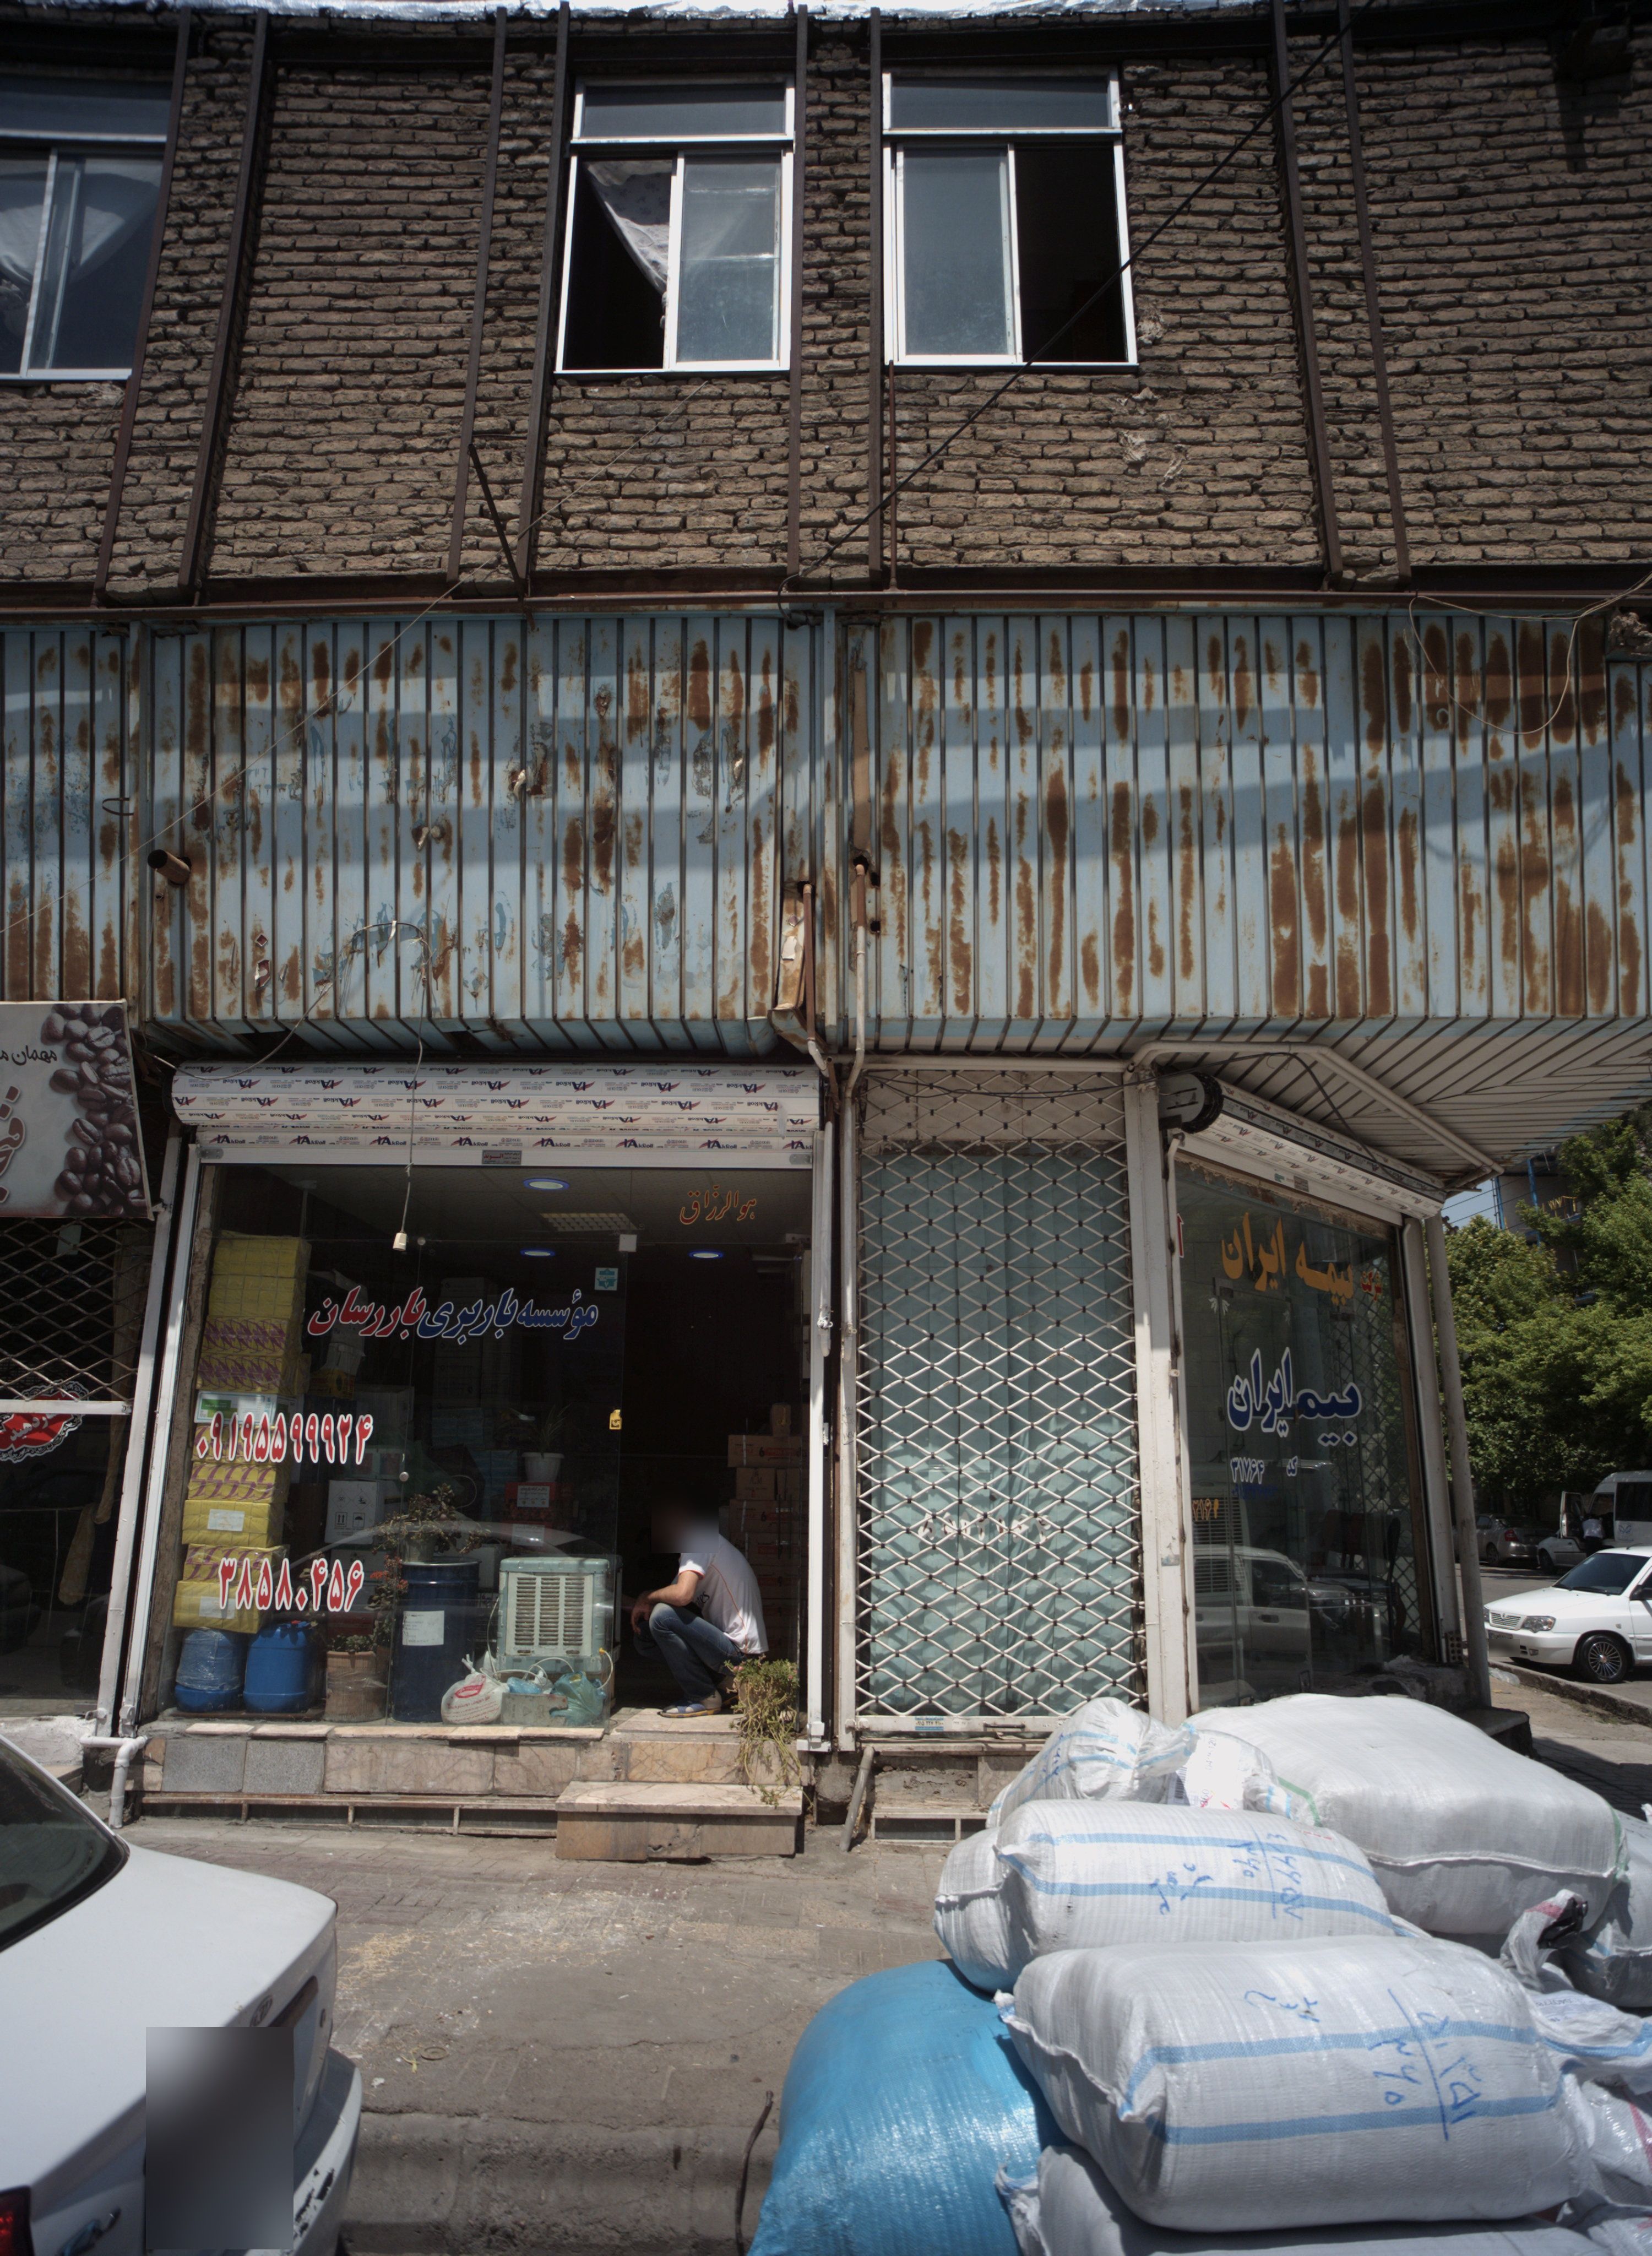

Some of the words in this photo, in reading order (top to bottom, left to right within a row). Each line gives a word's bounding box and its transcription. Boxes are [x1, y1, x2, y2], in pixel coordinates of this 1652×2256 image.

[1221, 1212, 1286, 1293] ایران
[1295, 1241, 1354, 1307] بیمه
[1227, 1346, 1294, 1438] ایران
[197, 1411, 374, 1466] ۰۹۱۹۵۵۹۹۹۲۴
[1286, 1455, 1298, 1477] کد
[1230, 1456, 1265, 1485] ۳۱۷۶۴
[218, 1557, 365, 1613] ۳۸۵۸۰۴۵۶
